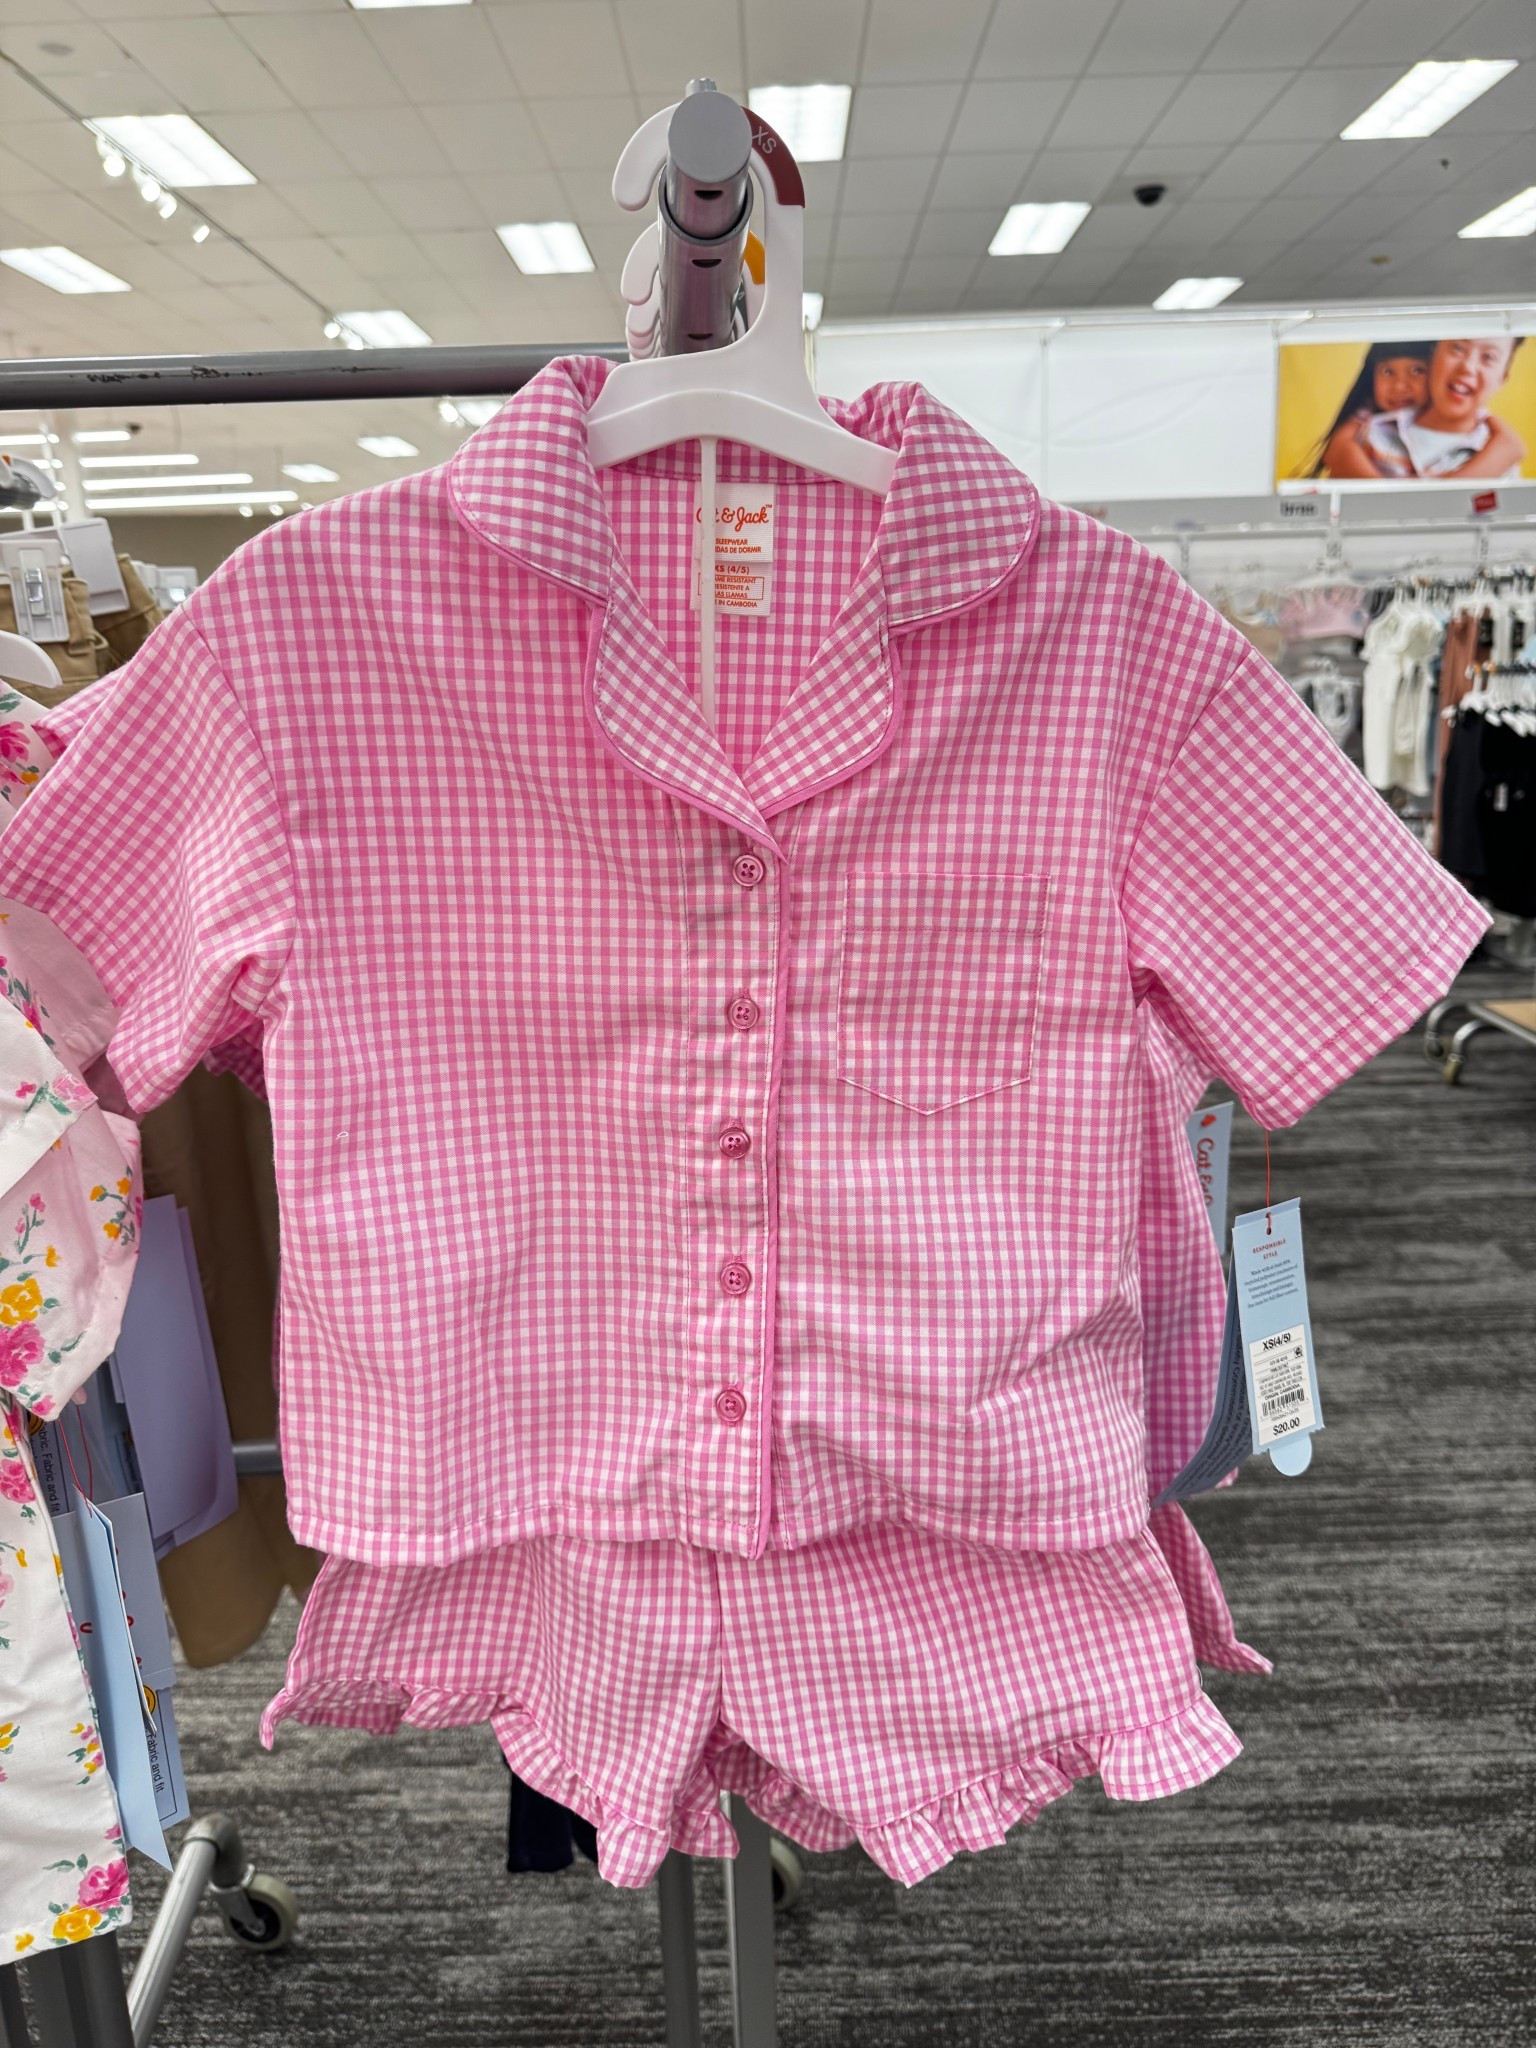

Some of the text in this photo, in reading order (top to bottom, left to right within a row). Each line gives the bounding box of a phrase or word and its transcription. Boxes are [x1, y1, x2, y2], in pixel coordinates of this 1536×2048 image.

[751, 125, 777, 154] XS
[721, 507, 735, 524] &
[727, 565, 750, 575] (4/5)
[726, 600, 758, 608] CAMBODIA
[1262, 1332, 1291, 1351] XS(4/5)
[1273, 1417, 1300, 1436] $20.00
[38, 1423, 60, 1512] abric. Fabric and fit
[146, 1733, 165, 1793] Fabric and fit
